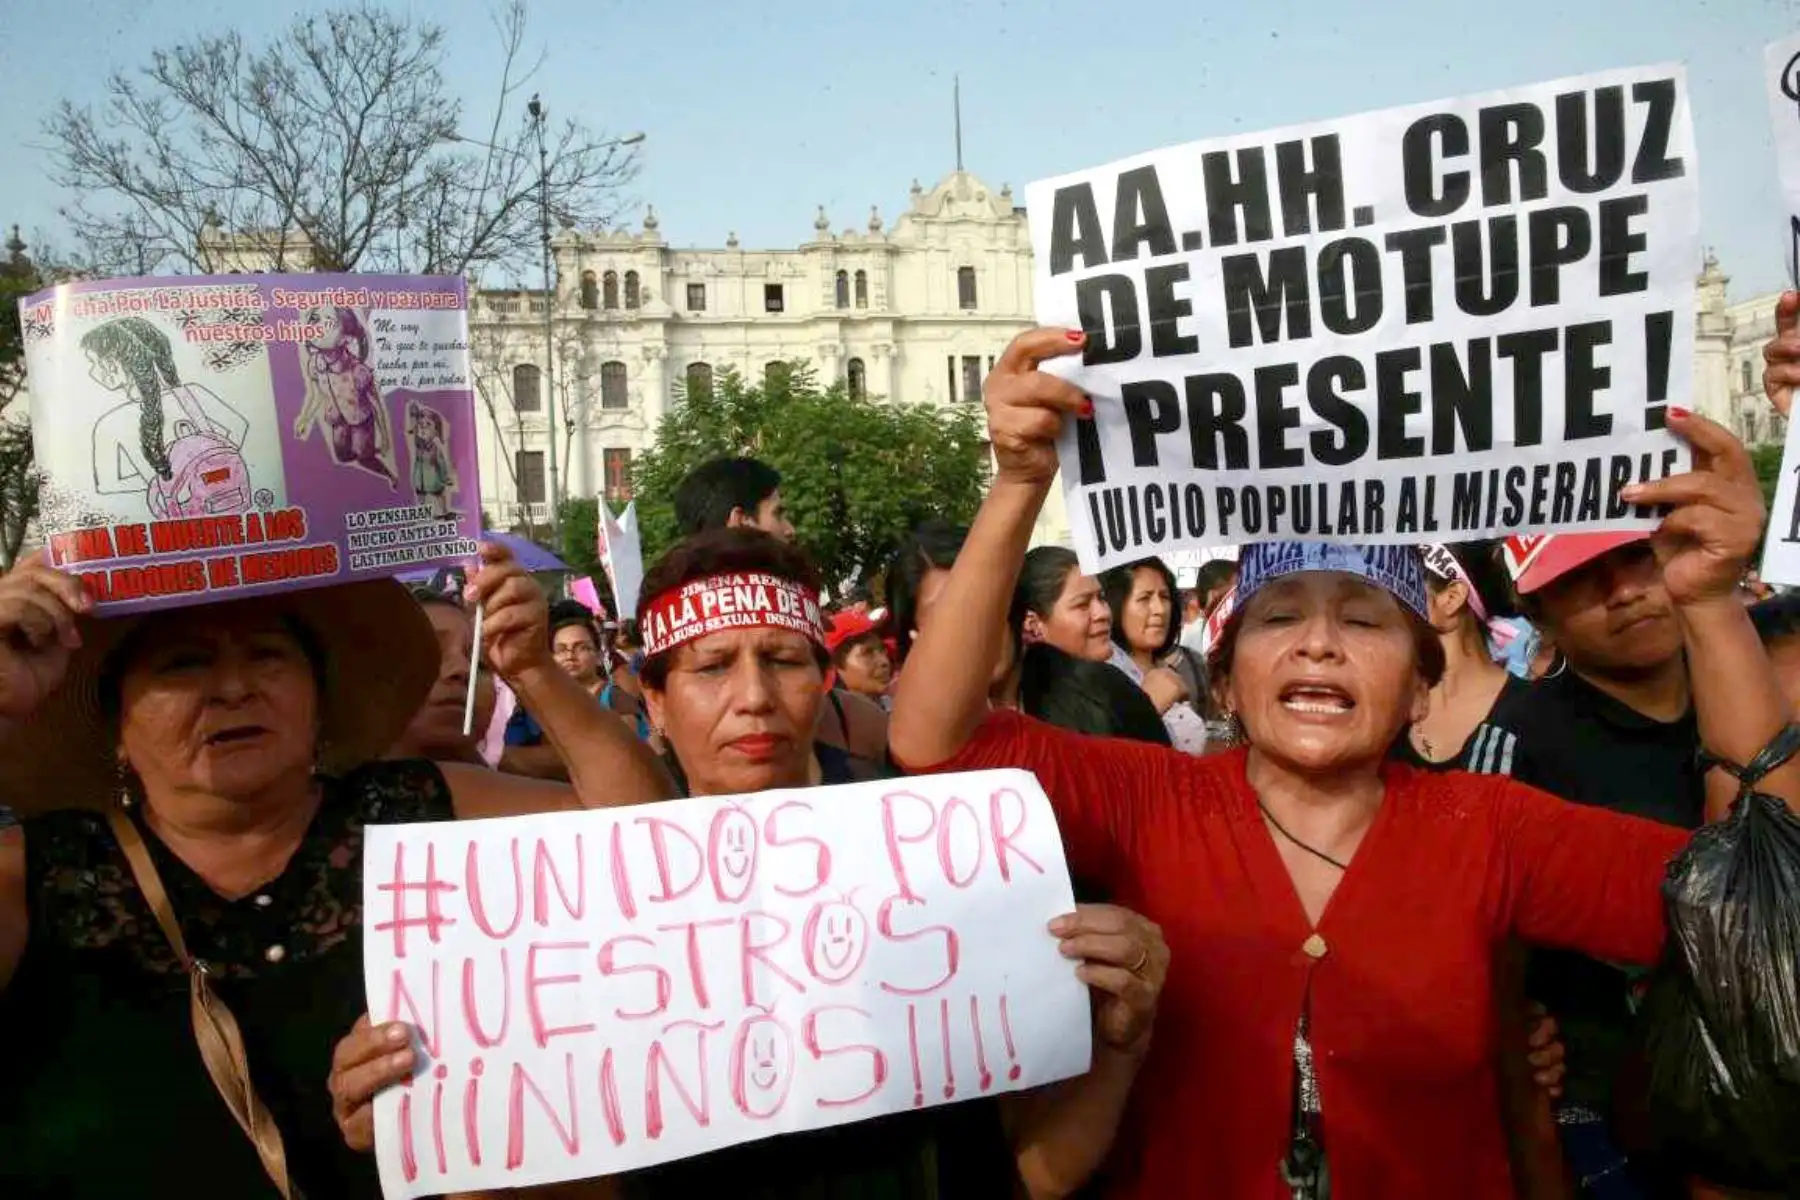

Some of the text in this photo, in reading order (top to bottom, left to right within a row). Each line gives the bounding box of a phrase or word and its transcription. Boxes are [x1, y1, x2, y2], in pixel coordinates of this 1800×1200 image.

[1049, 134, 1375, 276] AA.HH.
[1401, 77, 1686, 217] CRUZ
[274, 287, 368, 311] Seguridad
[422, 293, 459, 309] para
[1075, 264, 1199, 366] DE
[1222, 195, 1648, 348] MOTUPE
[186, 320, 273, 342] nuestros
[1121, 320, 1613, 470] PRESENTE
[115, 523, 150, 555] DE
[152, 515, 247, 553] MUERTE
[247, 512, 265, 543] A
[265, 508, 306, 541] LOS
[347, 513, 366, 527] LO
[350, 523, 457, 548] MUCHO ANTES DE
[1088, 483, 1206, 557] JUICIO
[1216, 477, 1385, 540] POPULAR
[1396, 474, 1439, 533] AL
[208, 556, 240, 590] DE
[242, 545, 338, 585] MENORES
[352, 538, 478, 569] LASTIMAR A UN NIÑO
[669, 598, 697, 628] LA
[701, 584, 773, 618] PENA
[777, 588, 803, 617] DE
[668, 622, 704, 646] ABUSO
[705, 612, 762, 632] SEXUAL
[881, 788, 1046, 903] POR
[390, 889, 960, 1060] NUESTROS
